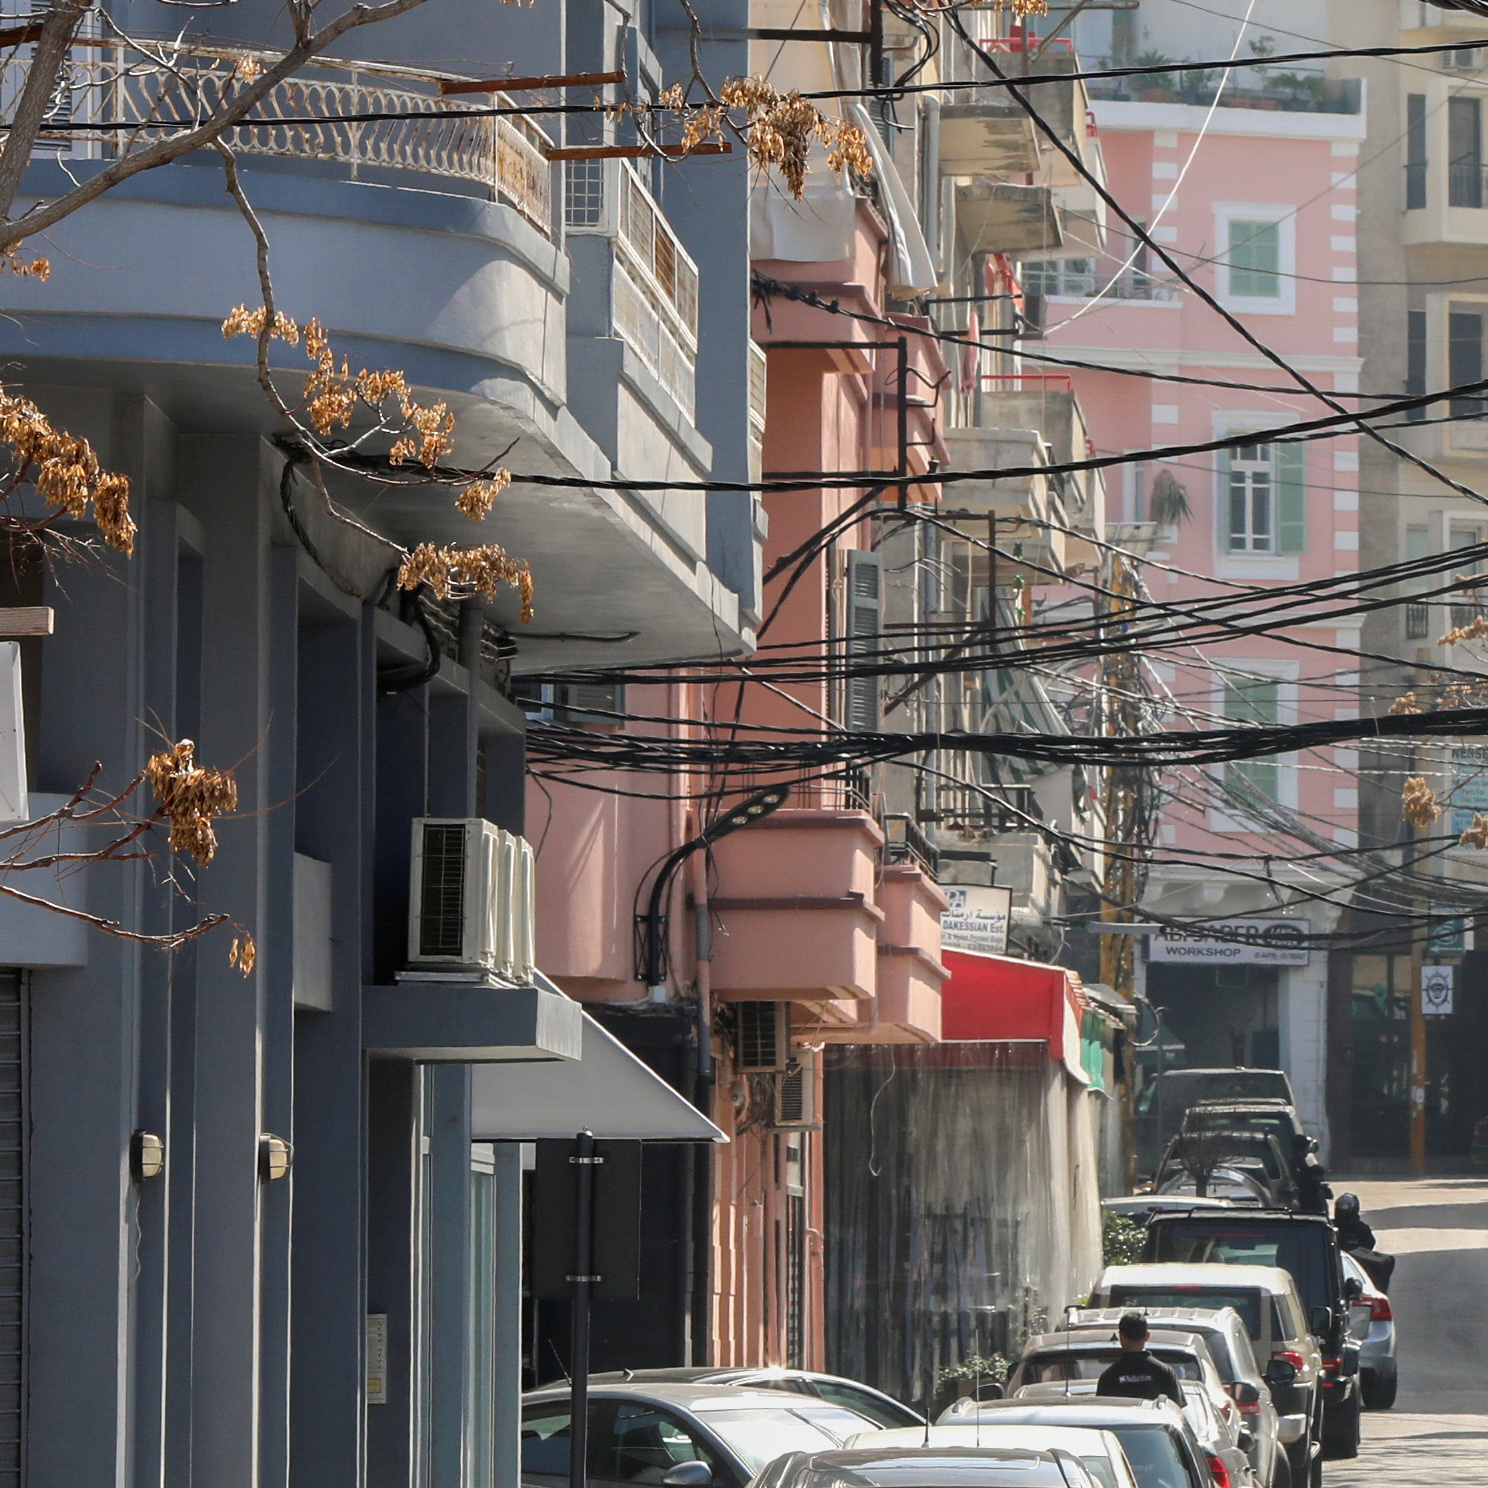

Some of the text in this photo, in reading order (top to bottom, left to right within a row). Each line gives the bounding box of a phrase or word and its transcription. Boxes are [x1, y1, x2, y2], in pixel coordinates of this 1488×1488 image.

[943, 920, 1005, 933] DAKESSIAN Est.
[1166, 946, 1241, 958] WORKSHOP
